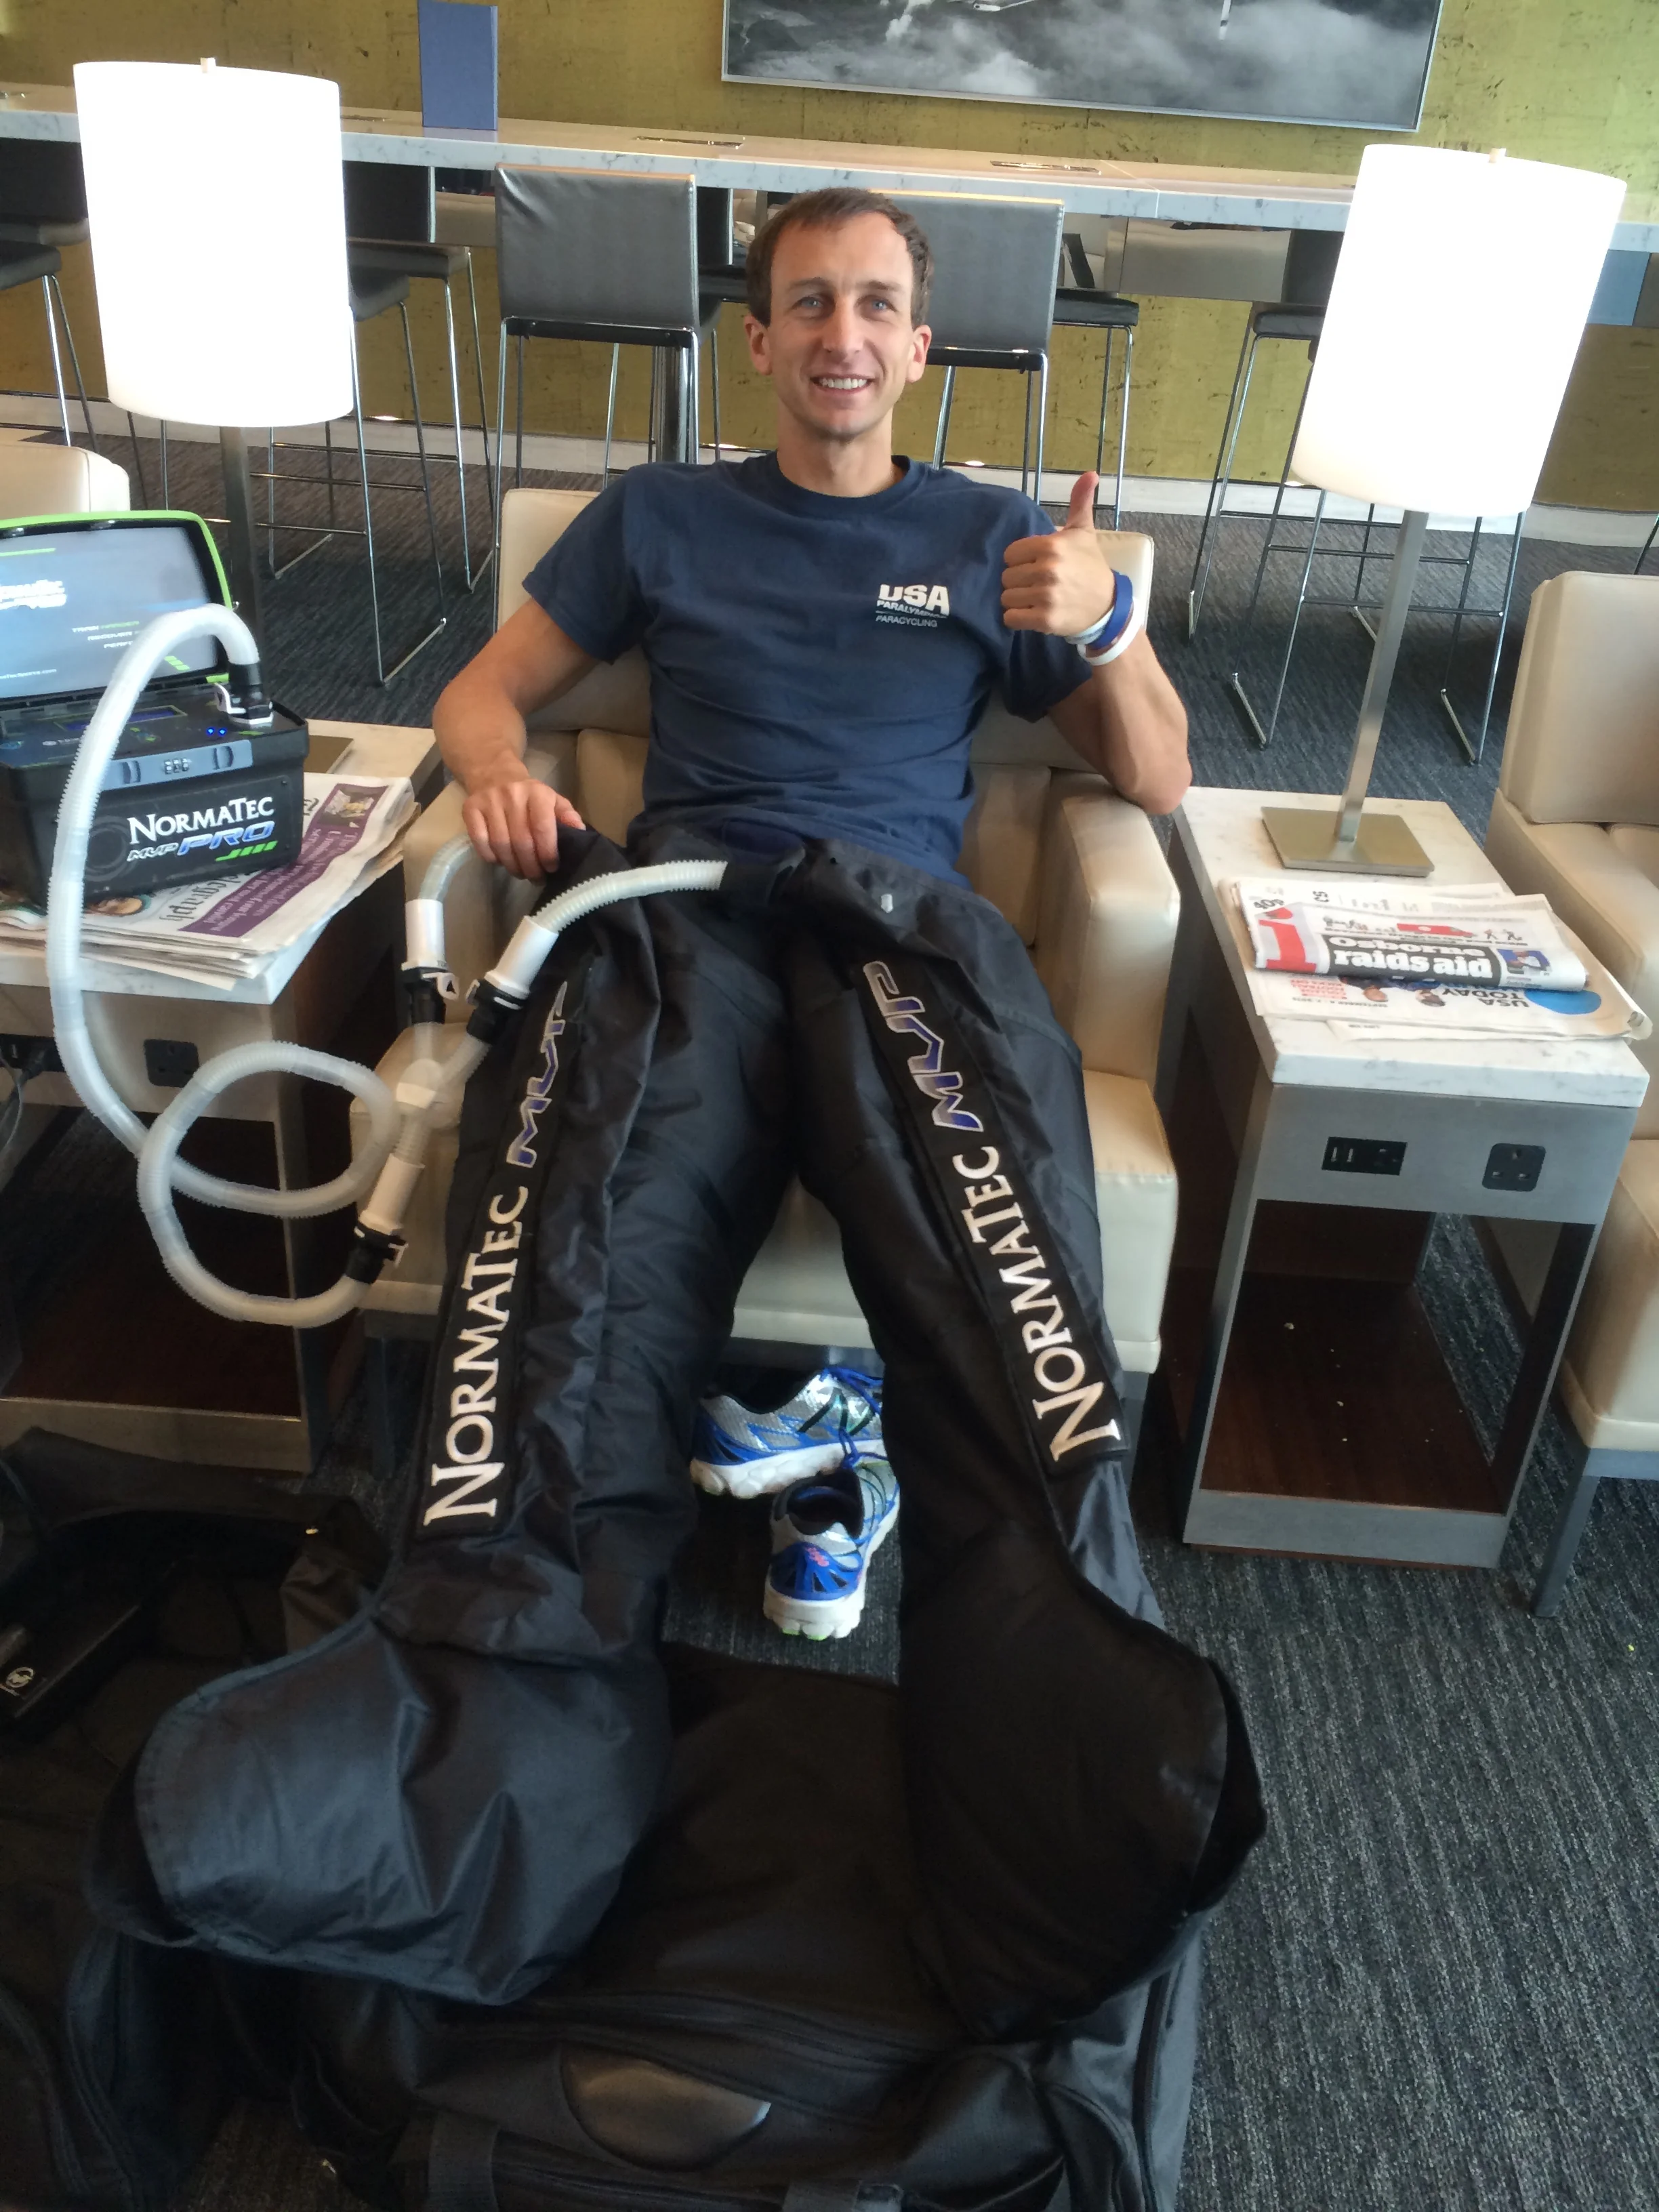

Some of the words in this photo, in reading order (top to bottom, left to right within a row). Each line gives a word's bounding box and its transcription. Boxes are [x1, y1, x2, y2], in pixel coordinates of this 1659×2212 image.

[879, 584, 949, 617] USA
[876, 615, 938, 628] PARACYCLING
[177, 821, 275, 856] PRO
[159, 875, 241, 921] elegraph
[1258, 907, 1317, 974] i
[1329, 937, 1486, 957] Osborne
[1333, 950, 1430, 972] raids
[1433, 956, 1493, 979] aid
[1441, 988, 1524, 1000] TODAY
[1478, 998, 1530, 1008] USA
[863, 960, 984, 1132] MVP
